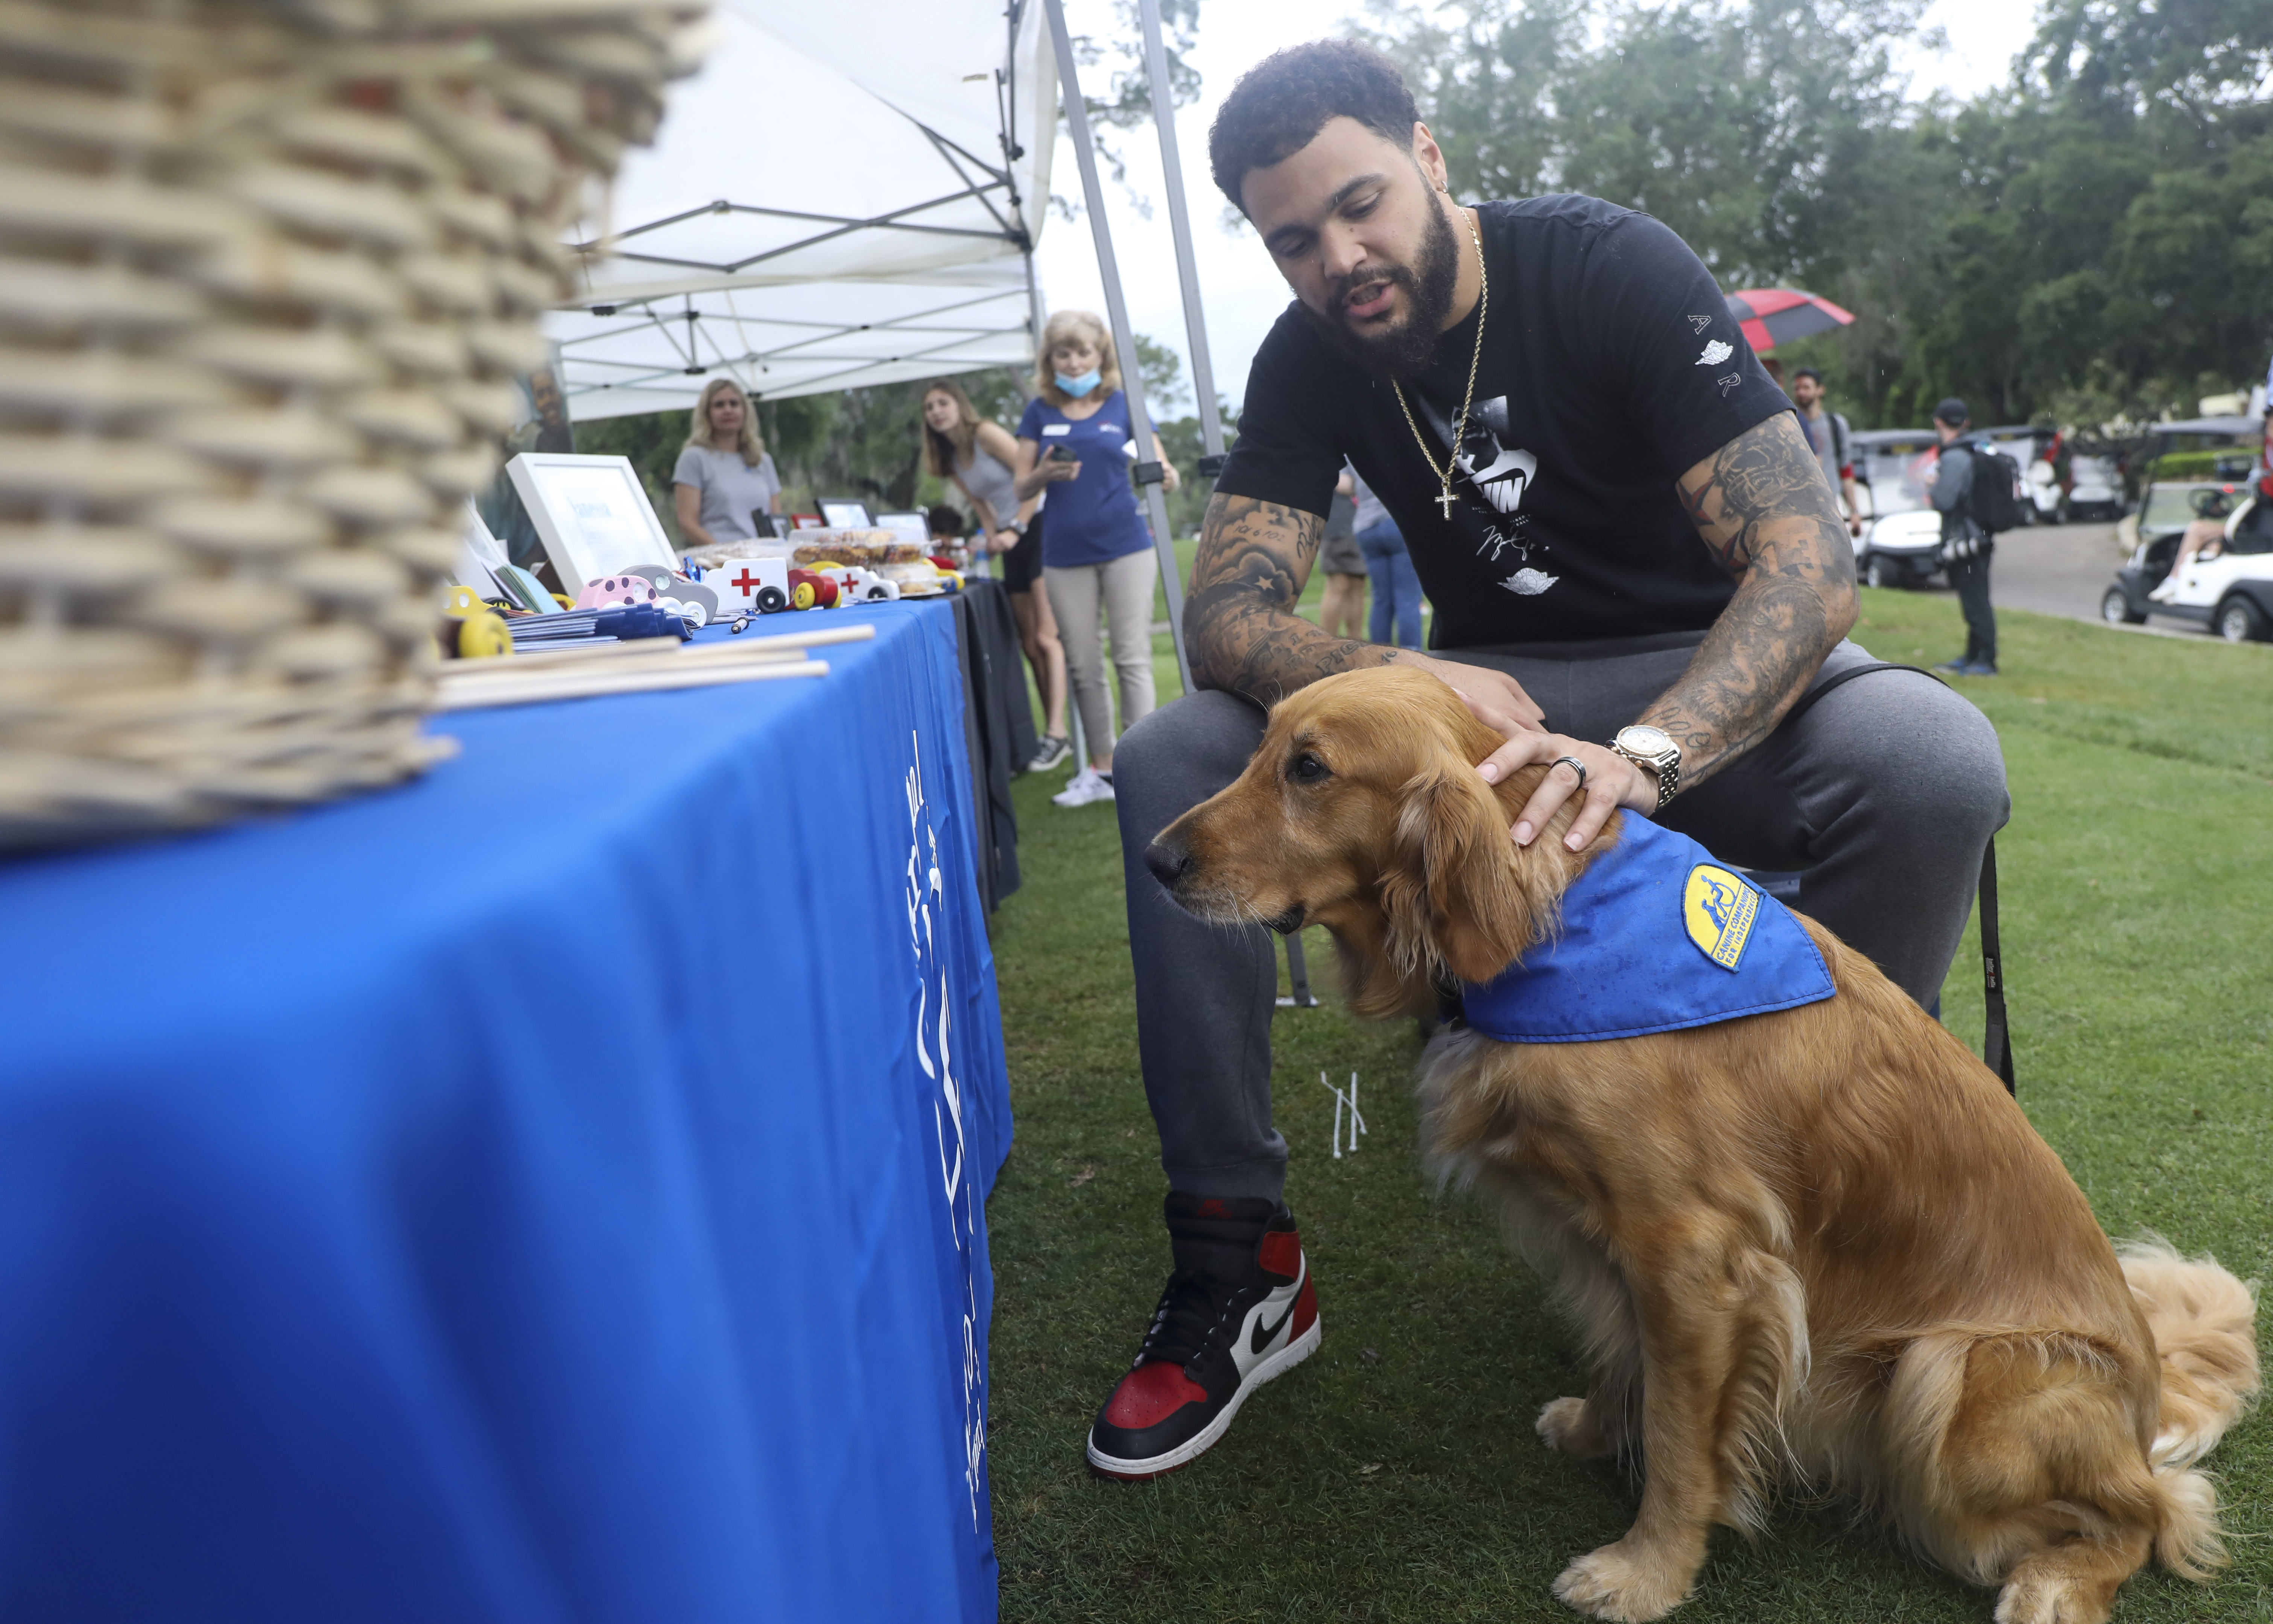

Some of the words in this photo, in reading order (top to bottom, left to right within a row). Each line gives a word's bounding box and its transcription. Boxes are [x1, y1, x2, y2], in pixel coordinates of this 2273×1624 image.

[1688, 315, 1712, 335] A
[1717, 372, 1741, 397] R
[1509, 575, 1520, 583] AIR
[1519, 568, 1546, 578] JORDAN
[1717, 928, 1735, 960] CANINE
[1731, 885, 1750, 929] COMPANIONS
[1725, 947, 1737, 964] FOR
